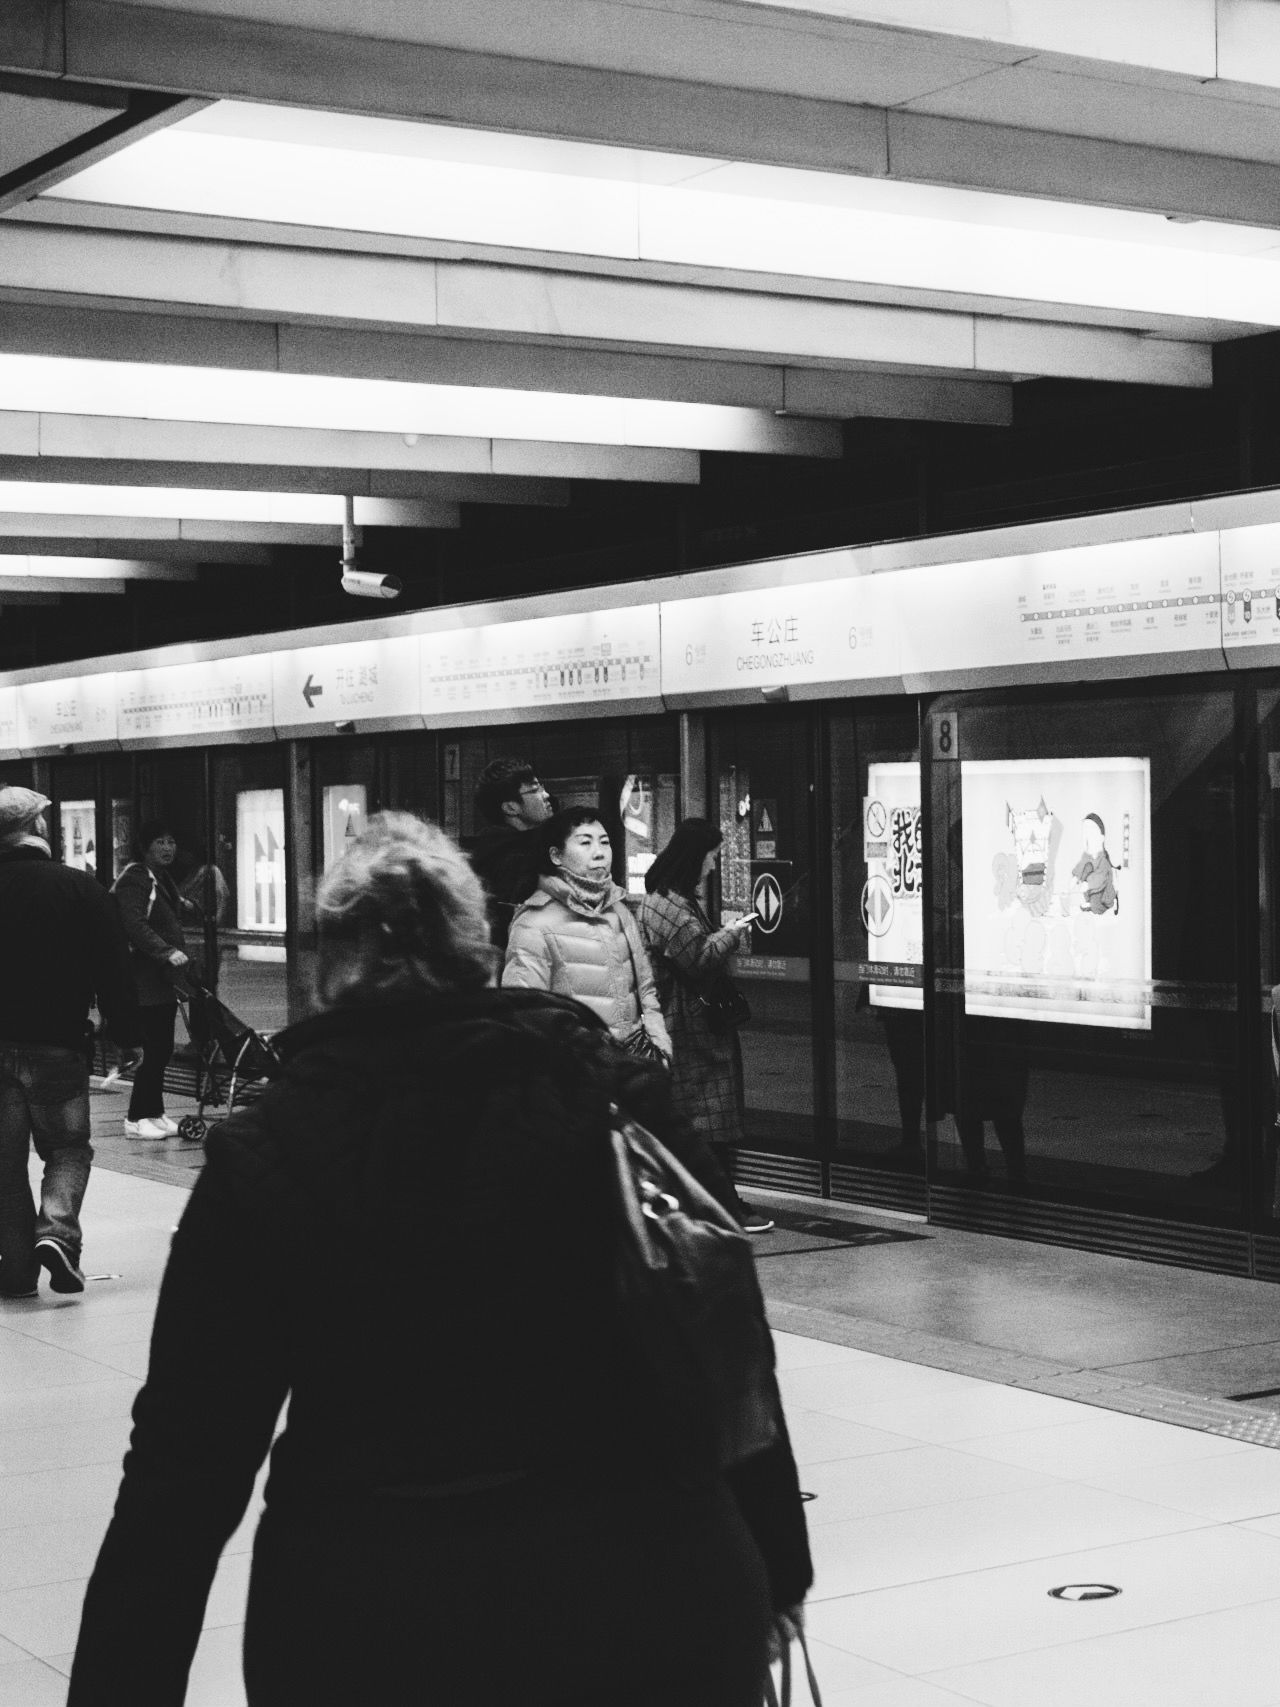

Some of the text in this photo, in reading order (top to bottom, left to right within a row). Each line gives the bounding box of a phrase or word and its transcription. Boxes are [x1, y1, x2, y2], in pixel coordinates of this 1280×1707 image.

[751, 616, 799, 648] 车公庄
[939, 719, 953, 753] 8
